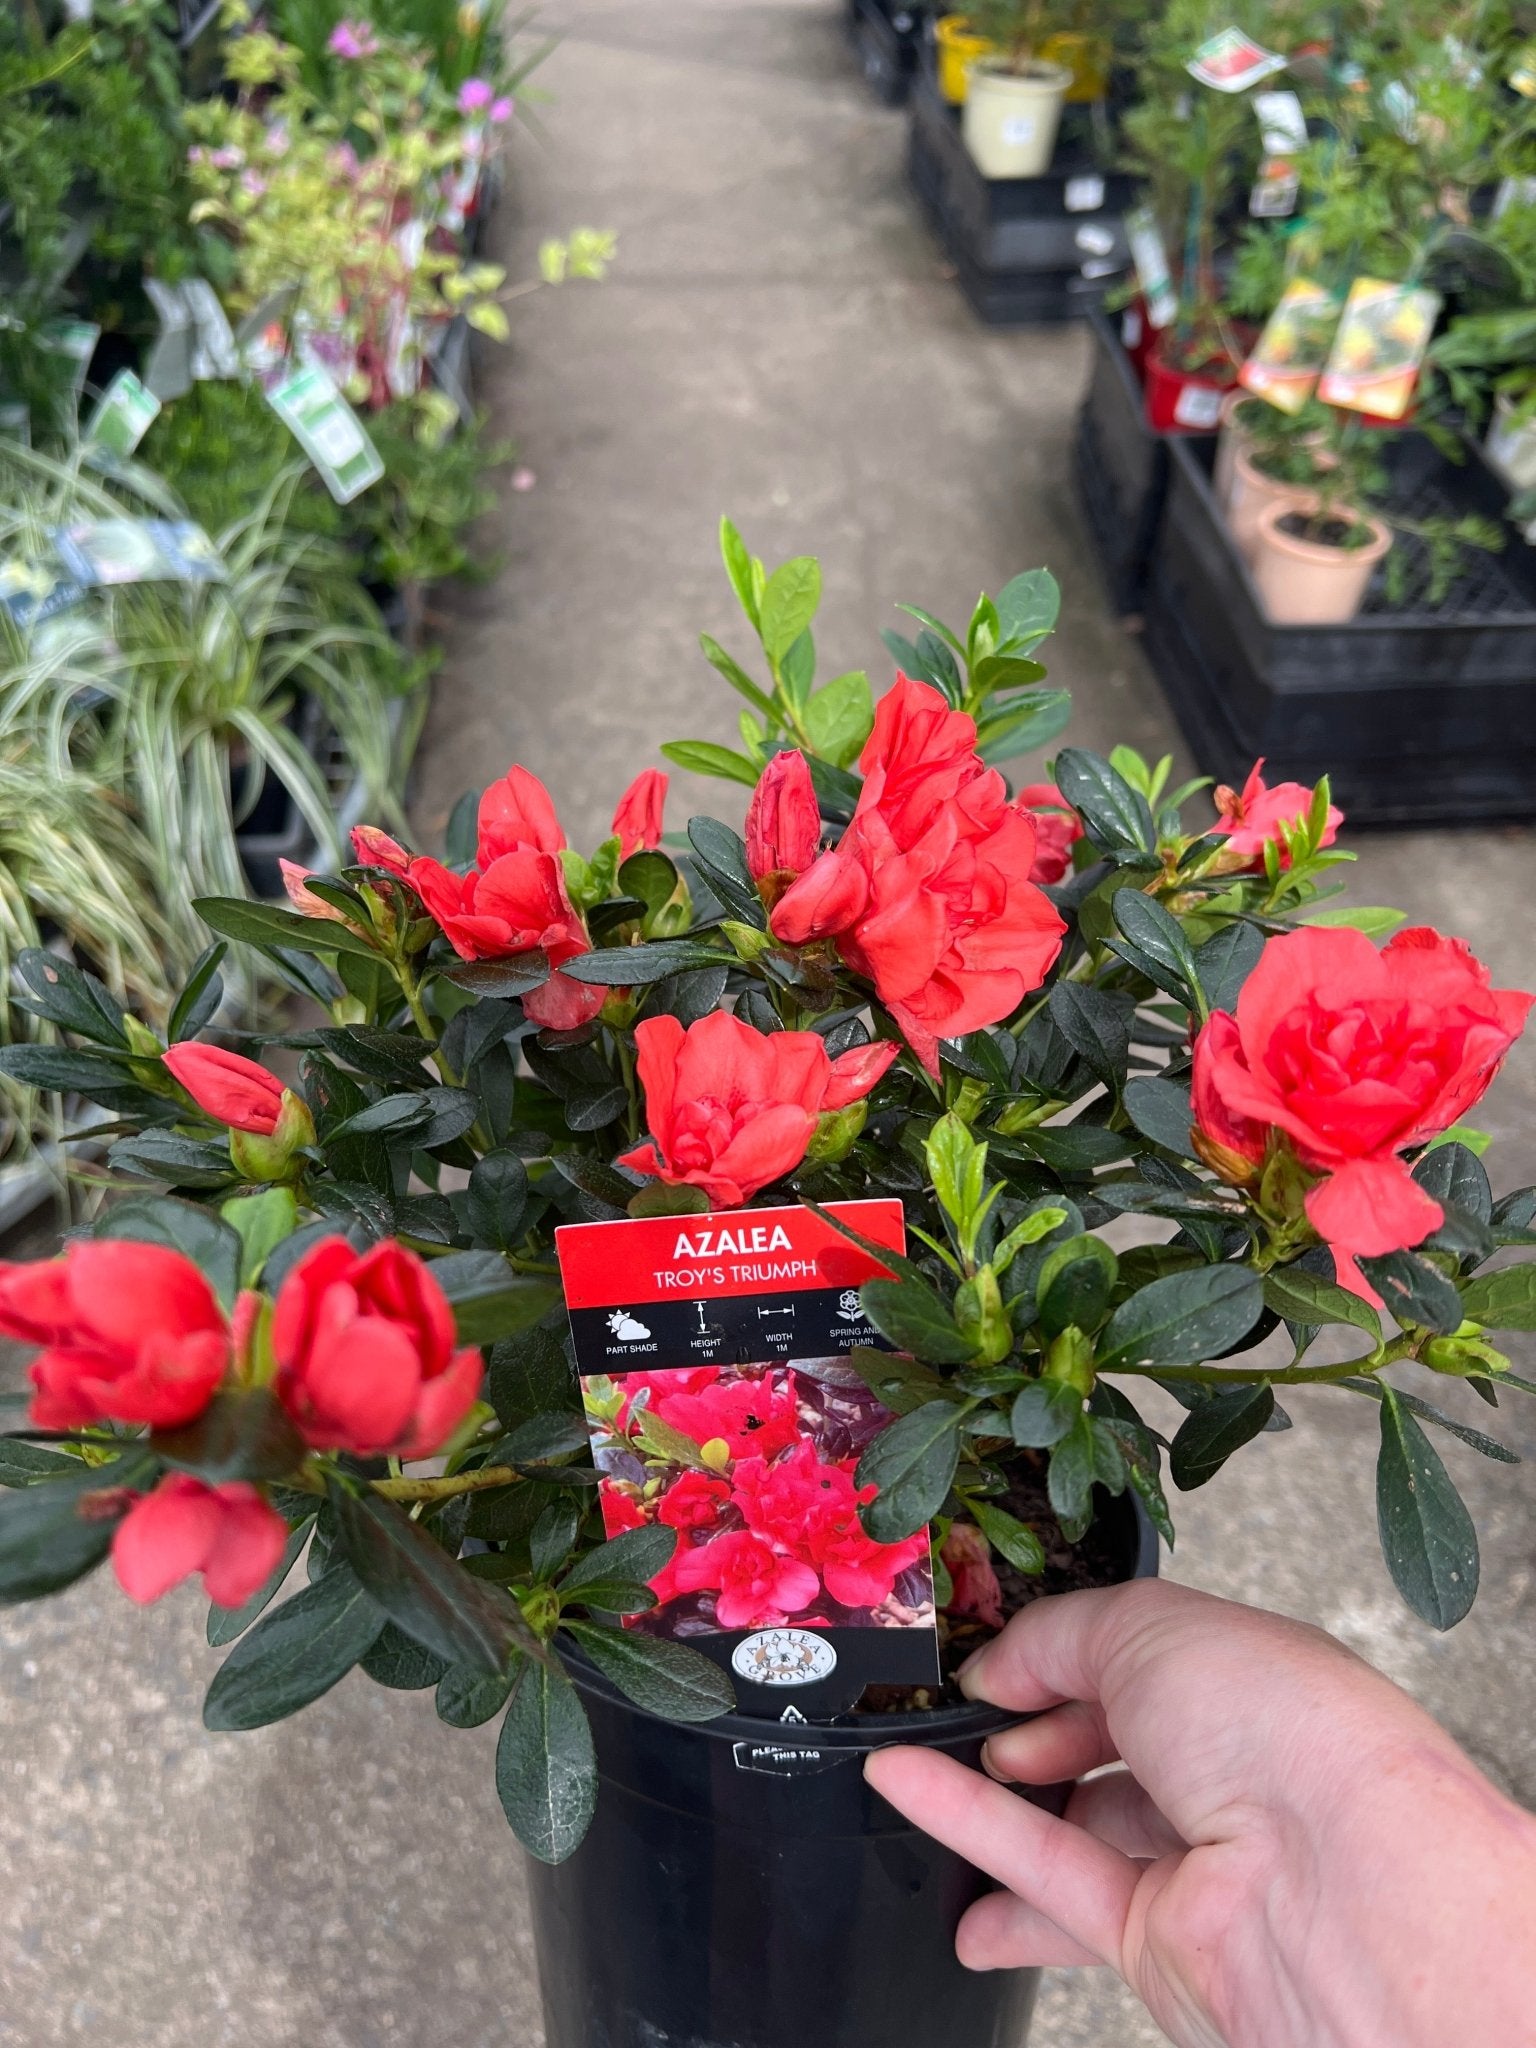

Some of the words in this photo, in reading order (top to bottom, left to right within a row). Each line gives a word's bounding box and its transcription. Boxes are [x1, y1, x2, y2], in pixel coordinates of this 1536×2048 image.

[673, 1225, 793, 1259] AZALEA
[653, 1267, 725, 1288] TROY'S
[729, 1259, 817, 1282] TRIUMPH
[829, 1327, 861, 1337] SPRING
[765, 1333, 793, 1342] WIDTH
[838, 1337, 874, 1347] AUTUMN
[690, 1338, 722, 1348] HEIGHT
[776, 1344, 788, 1352] 1M
[606, 1345, 628, 1355] PART
[630, 1343, 658, 1353] SHADE
[702, 1350, 714, 1358] 1M
[746, 1632, 821, 1656] AZALEA
[748, 1664, 821, 1681] GROVE
[773, 1751, 797, 1761] THIS
